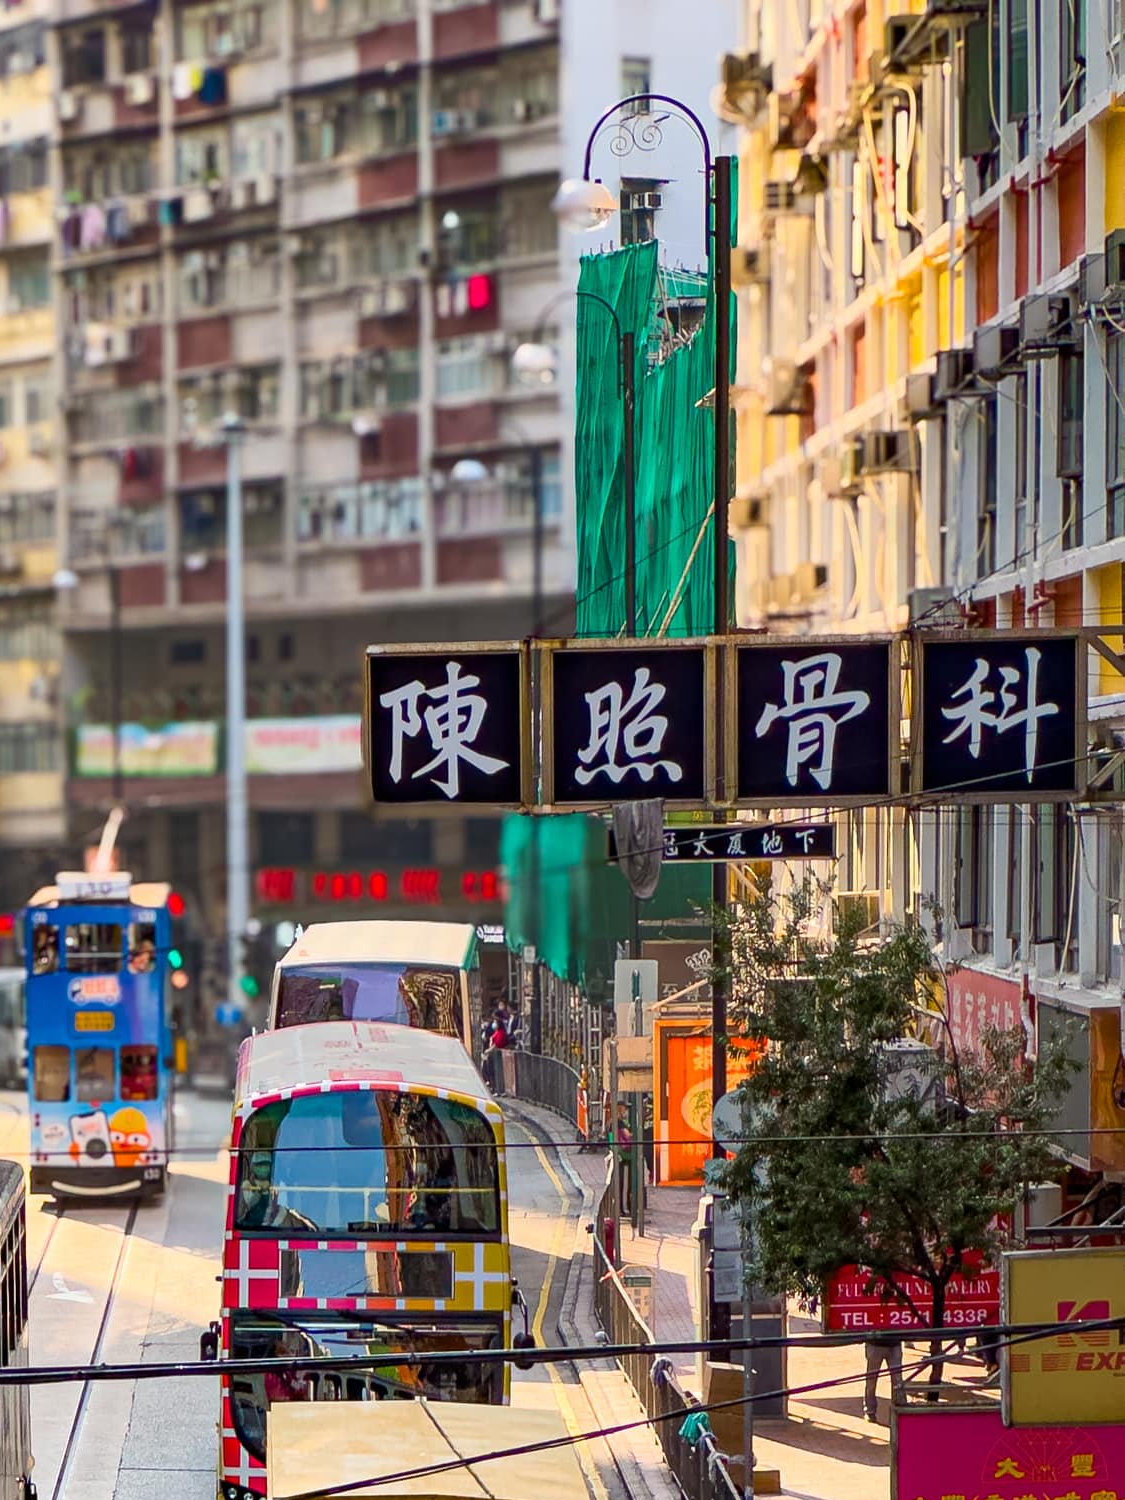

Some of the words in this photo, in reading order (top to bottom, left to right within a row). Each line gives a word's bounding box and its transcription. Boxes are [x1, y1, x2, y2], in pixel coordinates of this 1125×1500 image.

[379, 646, 1059, 799] 陳照骨科
[841, 1311, 874, 1326] TEL
[943, 1308, 988, 1324] 4338
